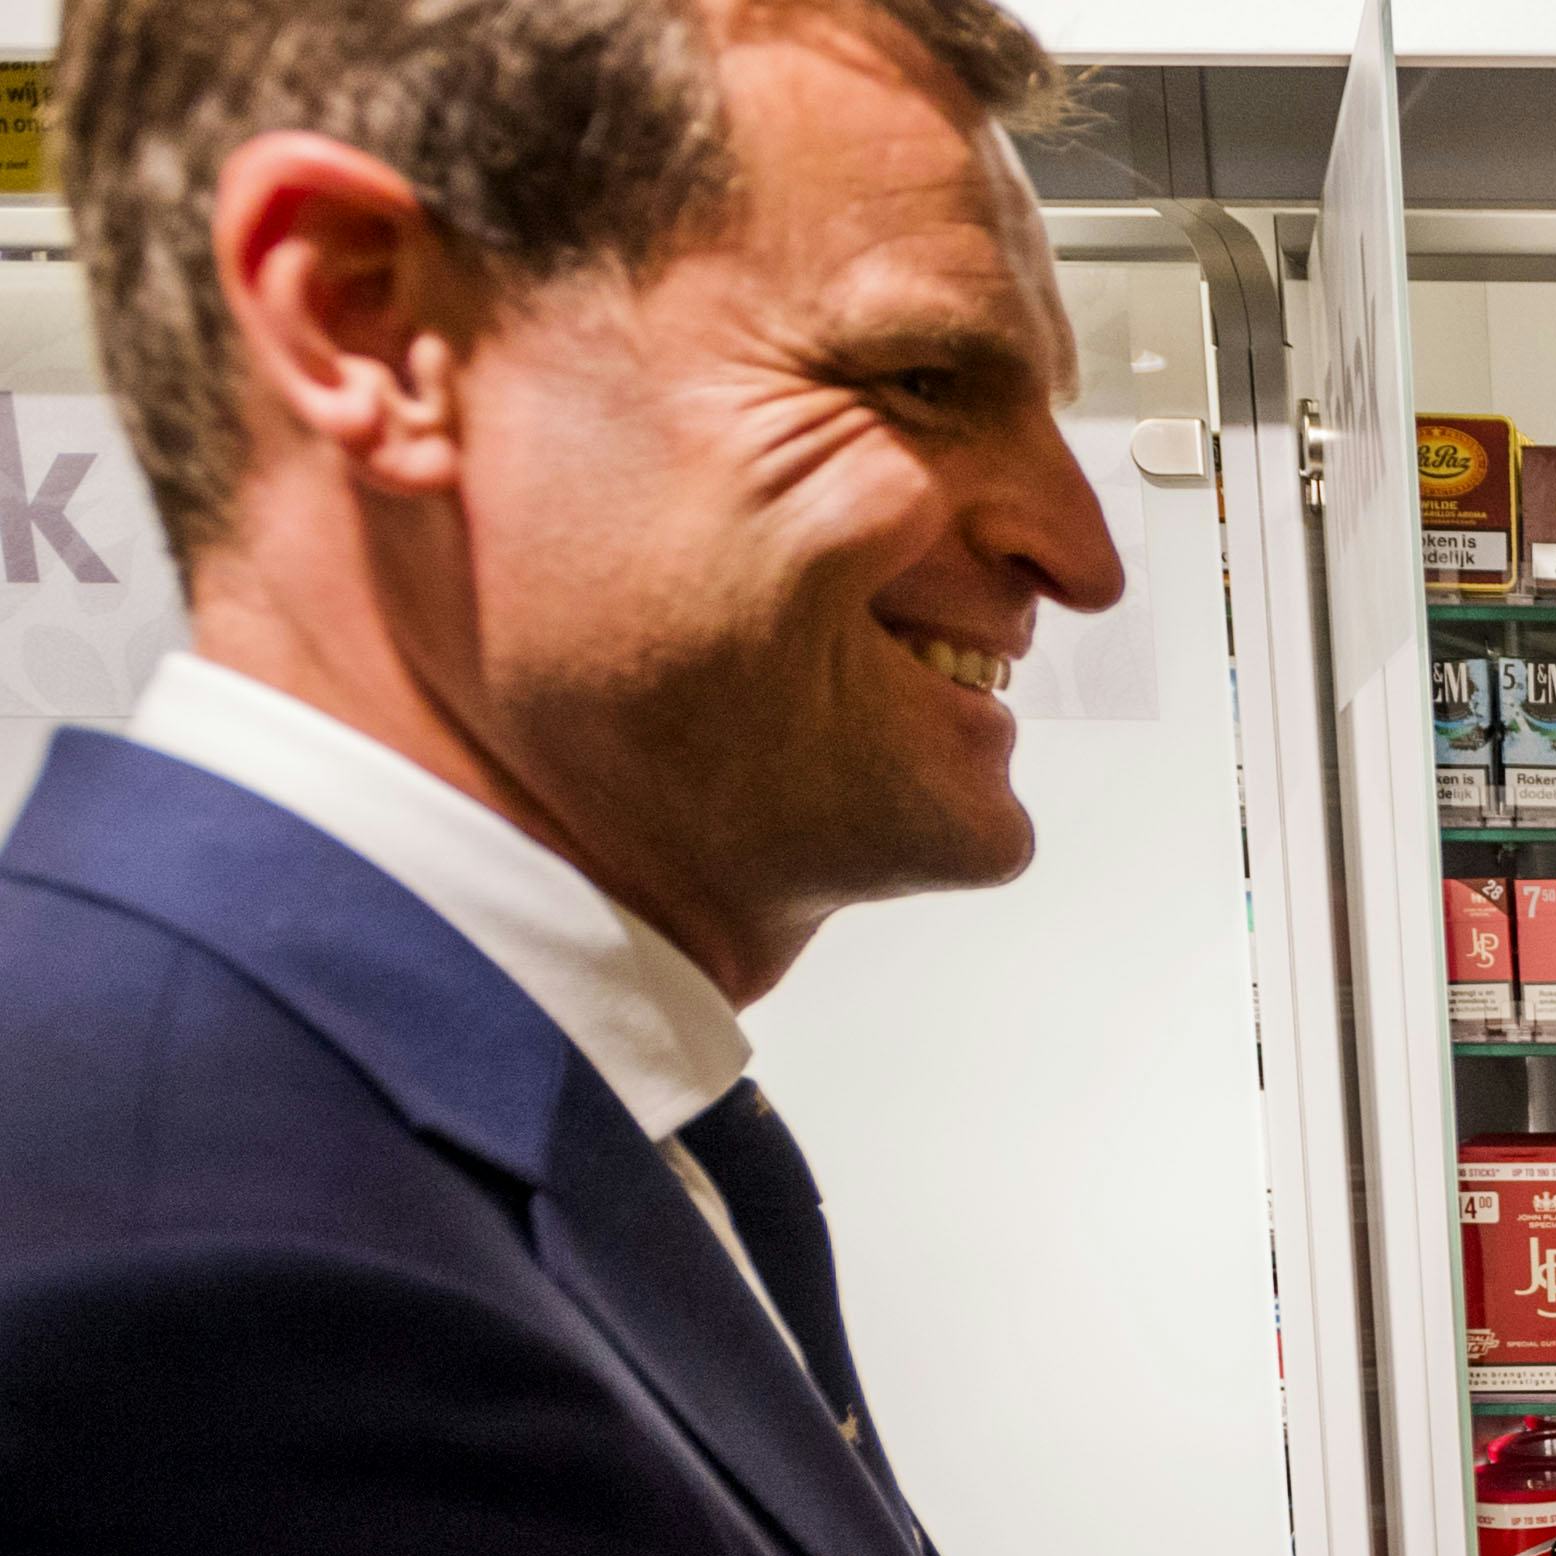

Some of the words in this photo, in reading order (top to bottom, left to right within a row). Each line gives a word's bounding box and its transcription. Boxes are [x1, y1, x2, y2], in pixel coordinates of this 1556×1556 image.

[1462, 534, 1477, 549] is
[1422, 551, 1476, 567] delijk
[1481, 879, 1504, 901] 28
